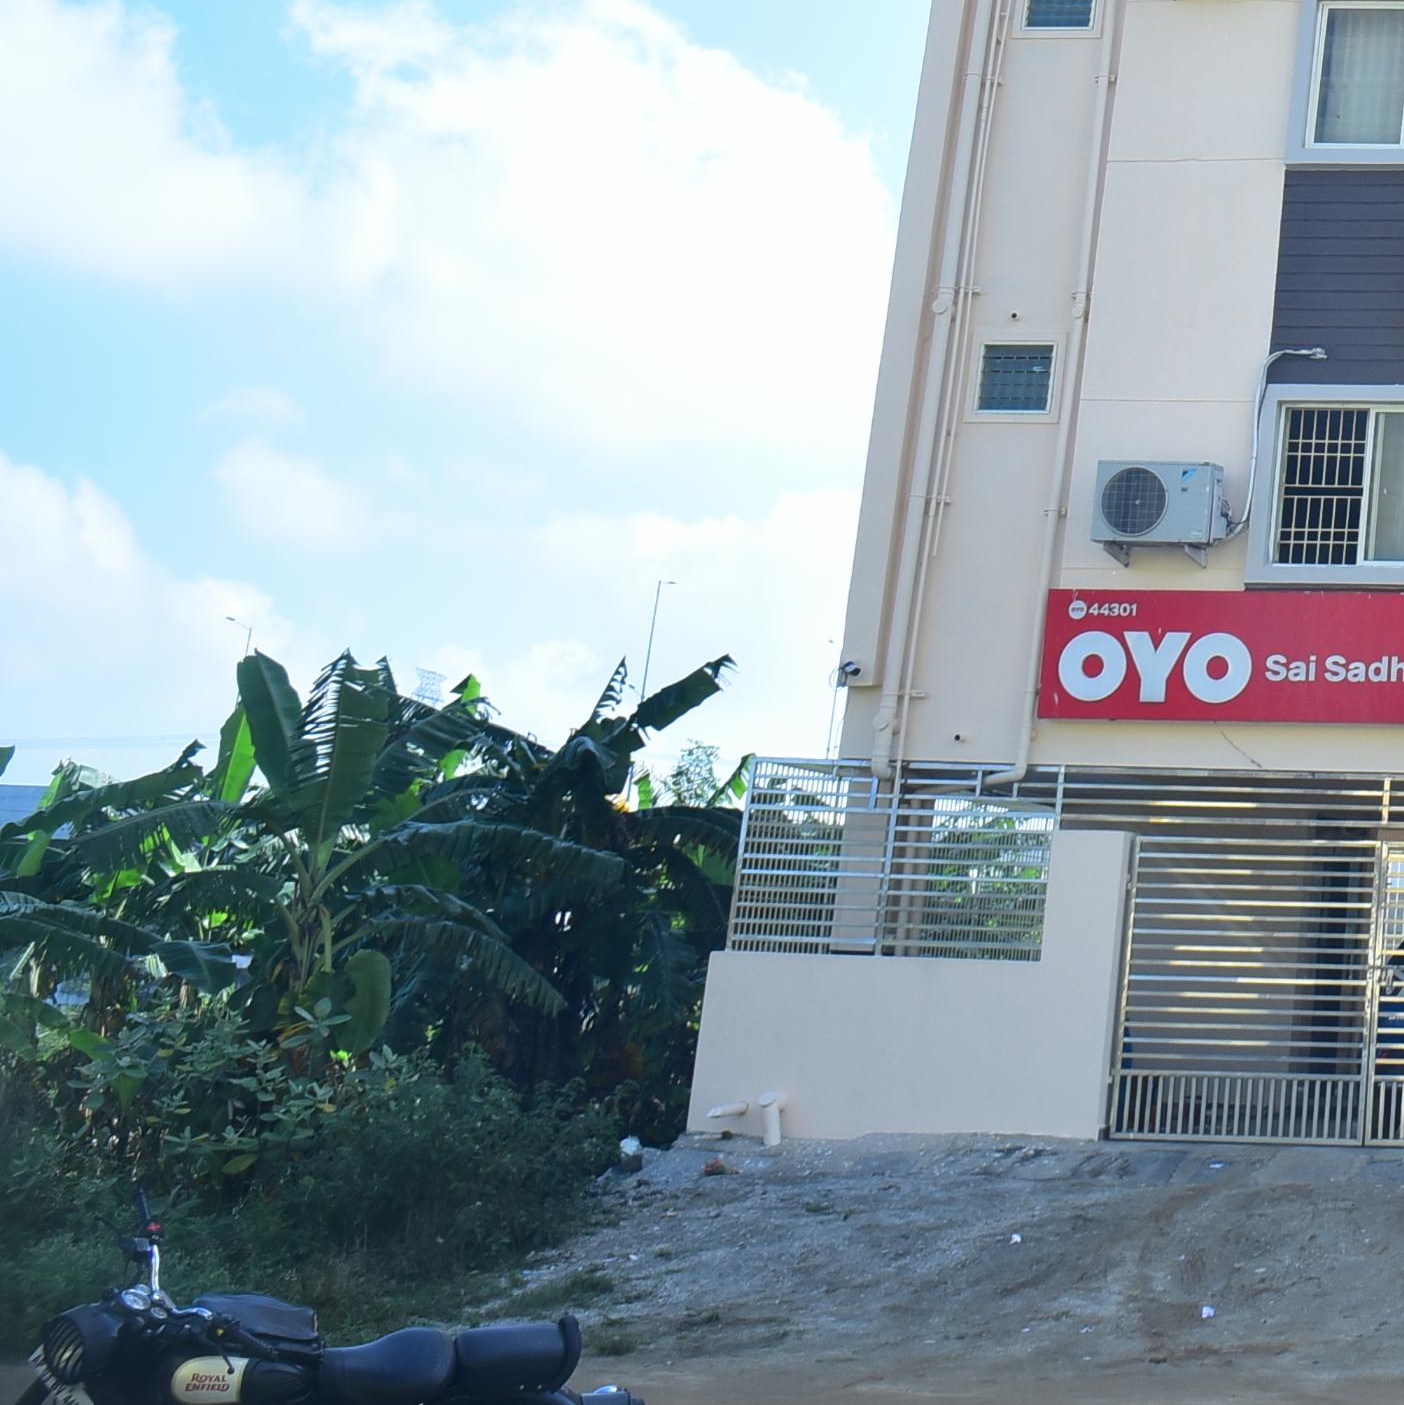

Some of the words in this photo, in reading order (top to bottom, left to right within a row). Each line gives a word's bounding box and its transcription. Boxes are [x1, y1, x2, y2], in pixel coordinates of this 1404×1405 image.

[1088, 602, 1137, 617] 44301
[1058, 630, 1253, 704] OYO
[1265, 654, 1317, 682] Sai
[191, 1372, 227, 1383] ROYAL
[185, 1382, 230, 1392] ENFIELD
